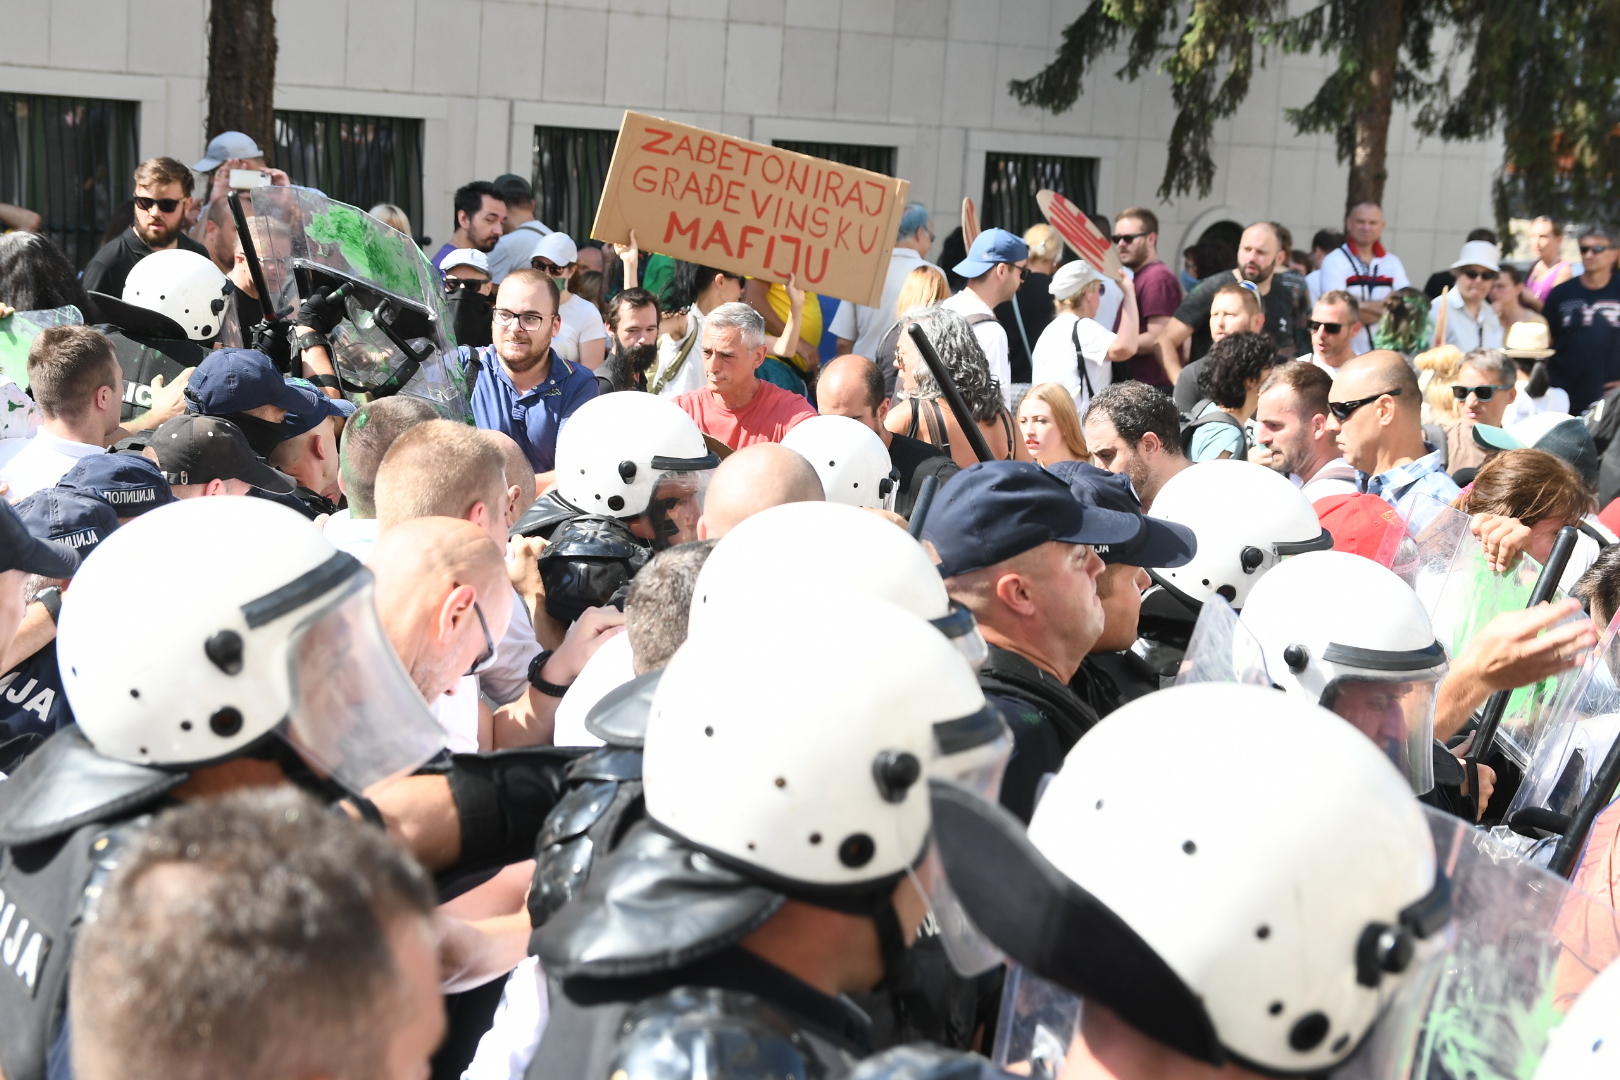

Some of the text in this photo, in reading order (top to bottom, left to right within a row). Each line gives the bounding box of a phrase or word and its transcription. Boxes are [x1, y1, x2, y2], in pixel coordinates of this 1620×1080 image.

[632, 165, 879, 255] GRAĐEVINSKU
[640, 127, 886, 217] ZABETONIRAJ
[663, 211, 831, 284] MAFIJU
